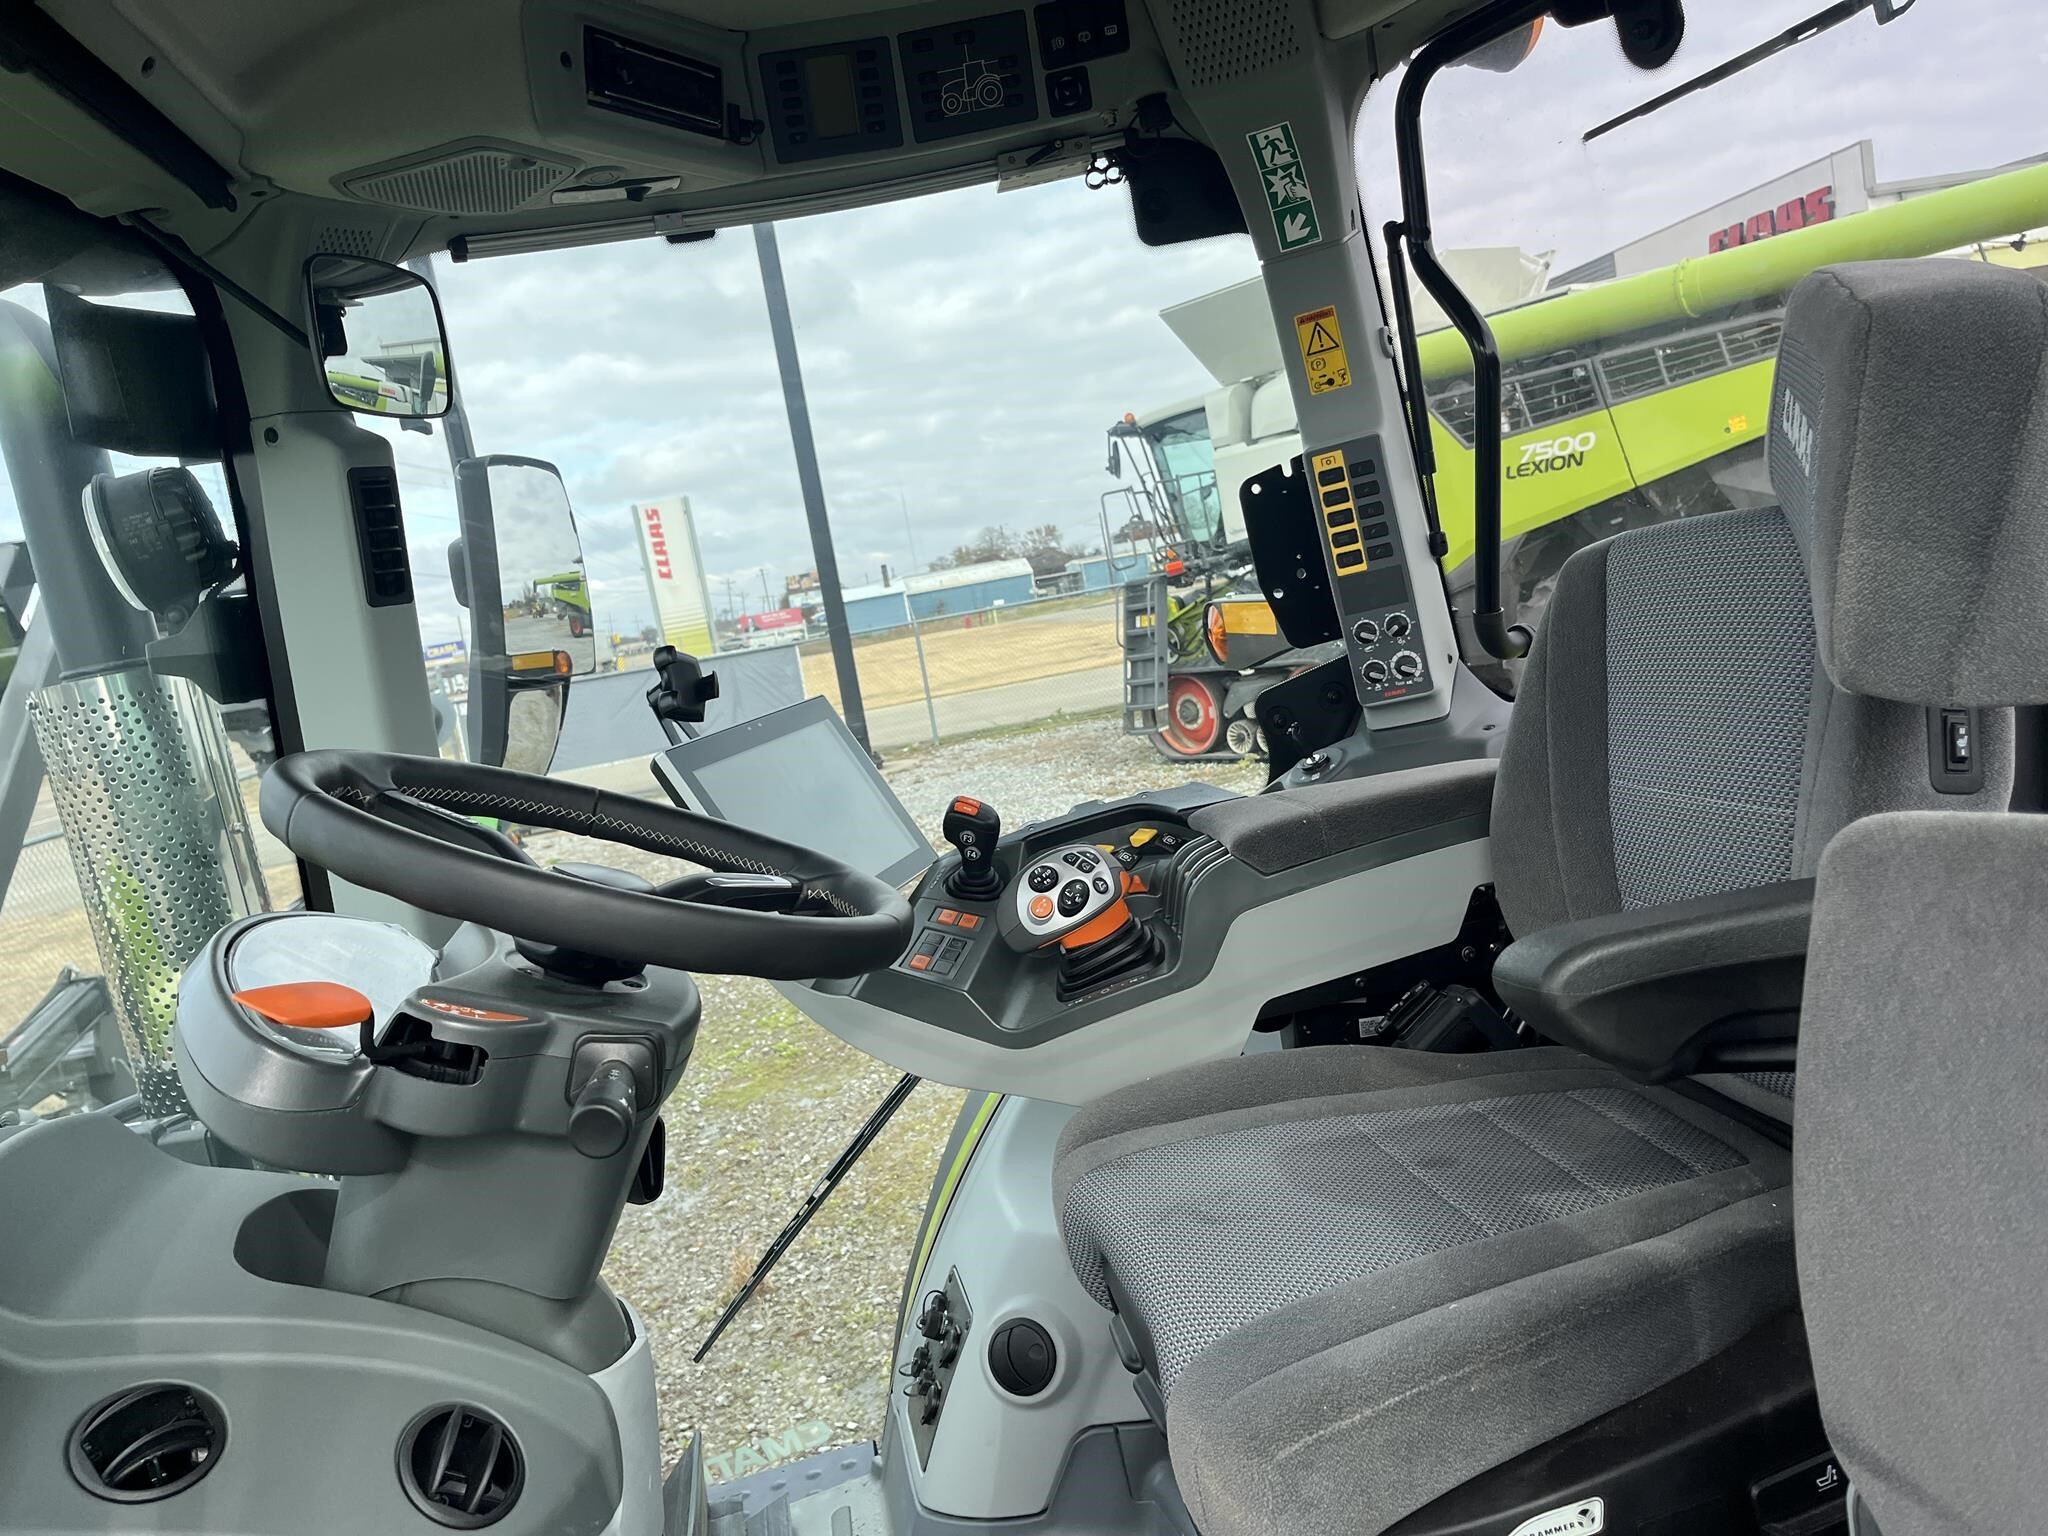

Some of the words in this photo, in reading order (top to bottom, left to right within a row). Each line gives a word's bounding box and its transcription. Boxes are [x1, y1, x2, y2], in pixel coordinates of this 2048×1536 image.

[1520, 432, 1596, 464] 7500
[1506, 451, 1584, 480] LEXION
[645, 508, 672, 580] CLAAS
[963, 834, 973, 843] F3
[967, 850, 977, 859] F4
